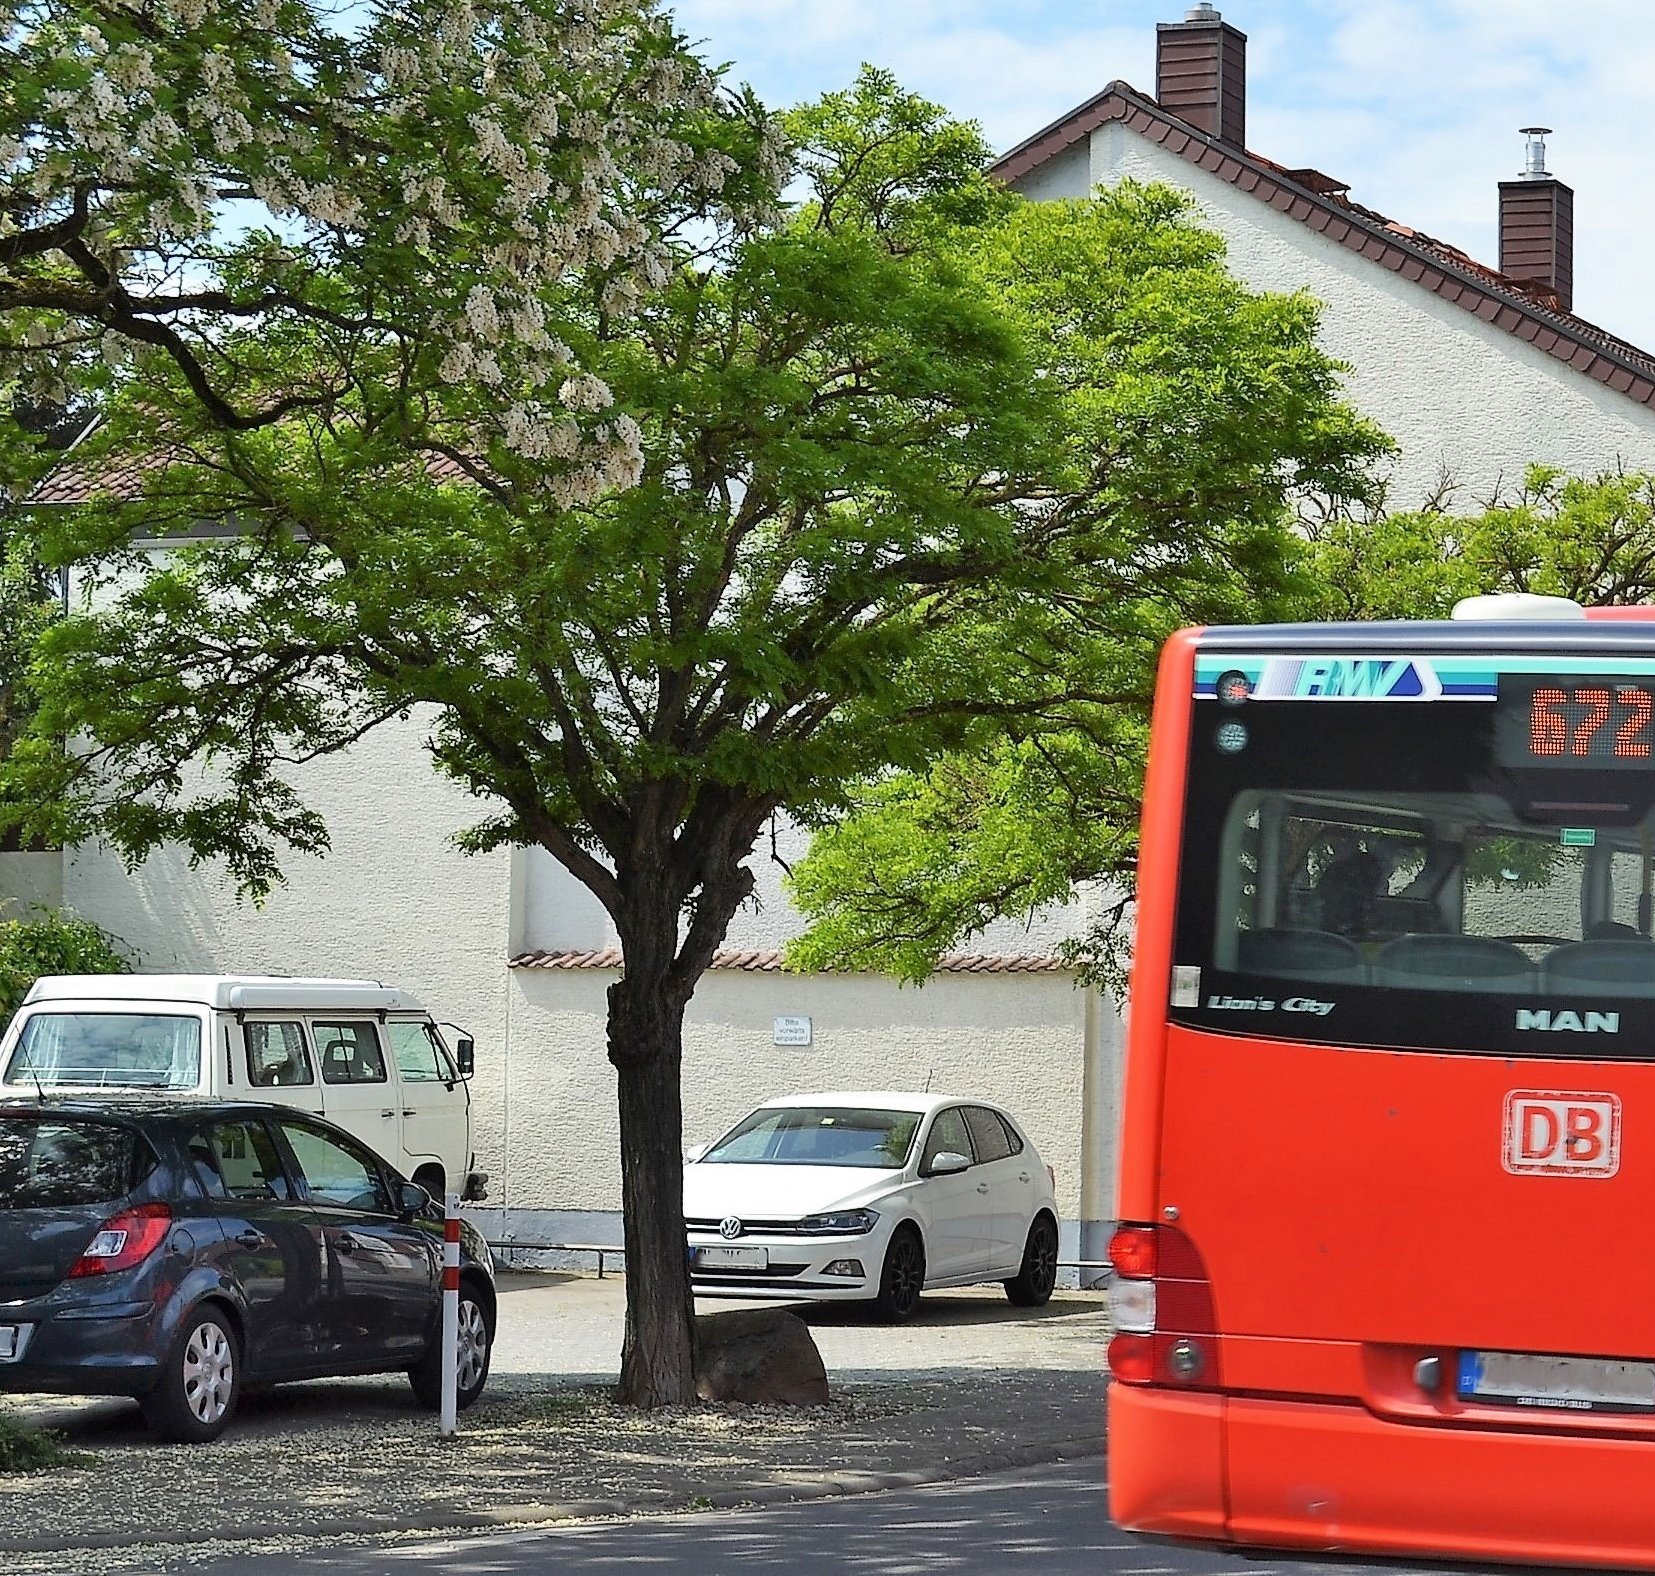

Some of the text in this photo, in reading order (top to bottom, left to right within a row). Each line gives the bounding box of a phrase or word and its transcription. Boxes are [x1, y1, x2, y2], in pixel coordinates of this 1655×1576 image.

[1296, 660, 1412, 696] RMV
[1529, 688, 1653, 756] 672
[1207, 994, 1336, 1016] Lion's City
[1515, 1009, 1620, 1033] MAN
[1521, 1105, 1604, 1162] DB
